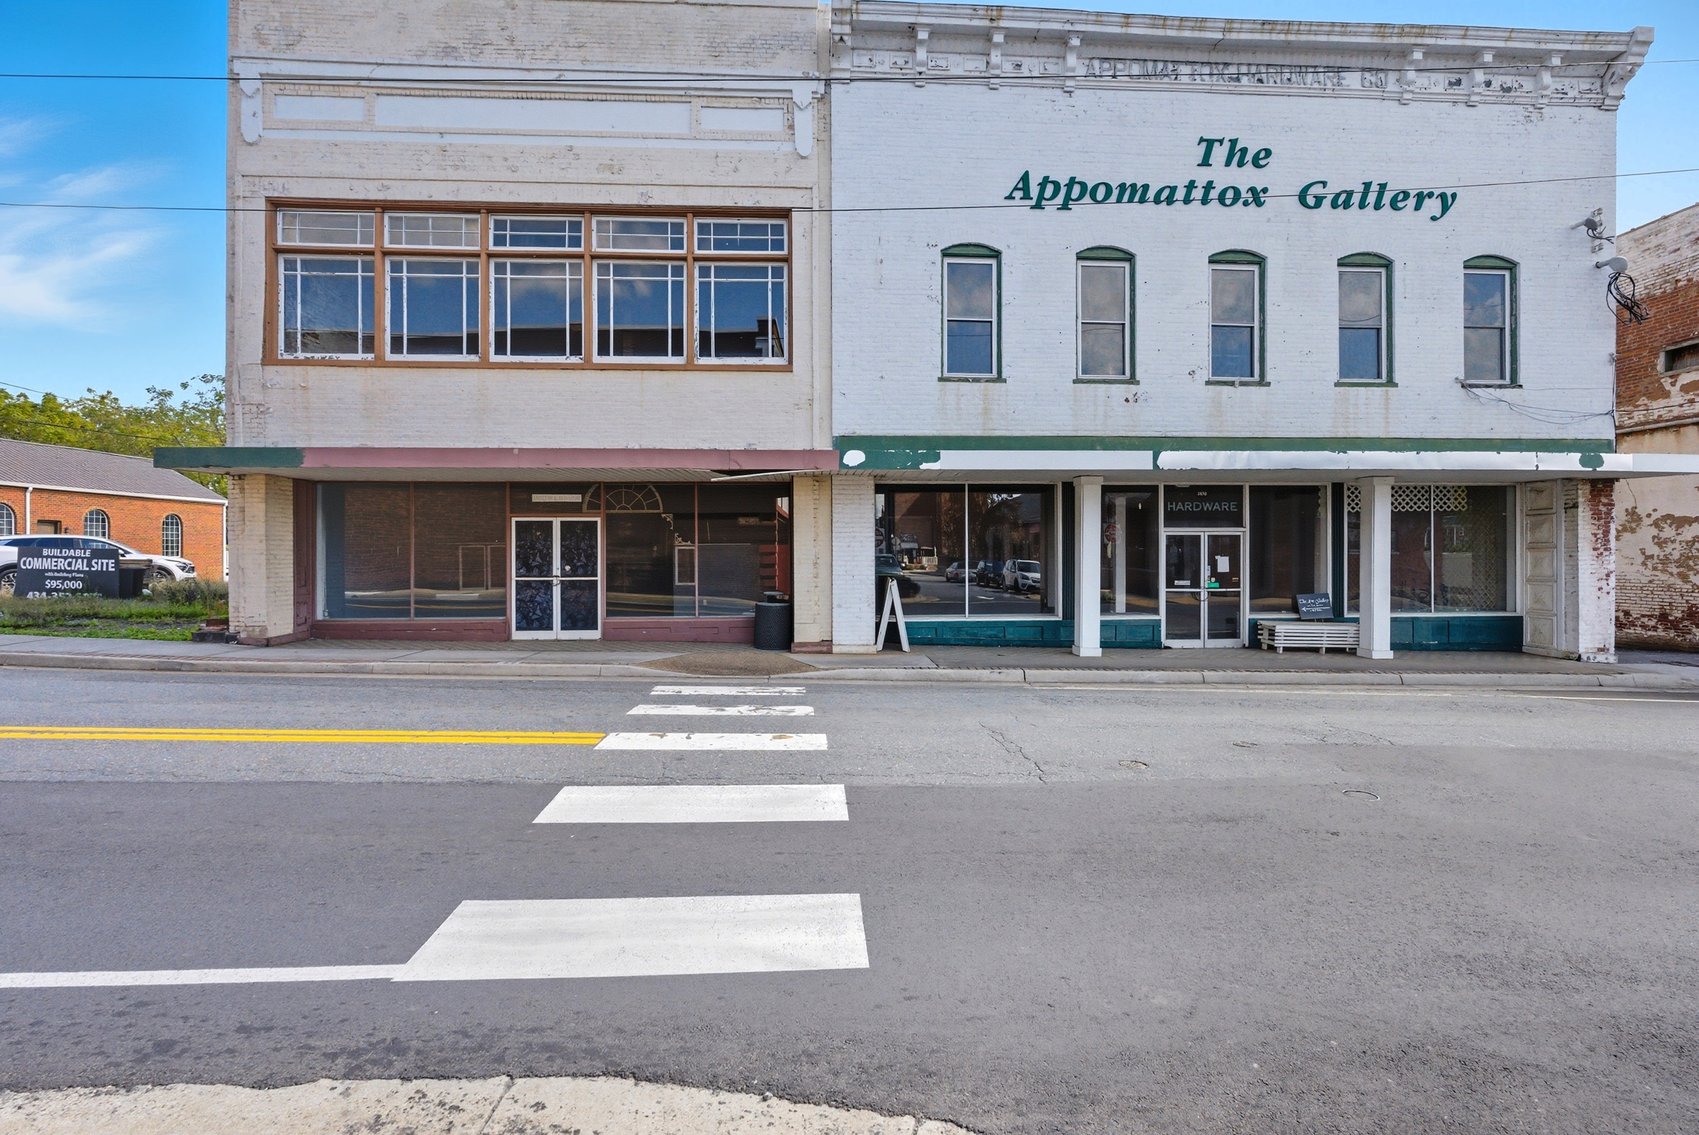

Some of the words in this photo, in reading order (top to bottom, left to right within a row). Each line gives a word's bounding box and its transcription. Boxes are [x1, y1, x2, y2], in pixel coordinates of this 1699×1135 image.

[1196, 135, 1273, 169] The
[1003, 169, 1270, 211] Appomattox
[1297, 180, 1458, 222] Gallery
[1167, 501, 1238, 512] HARDWARE
[42, 548, 91, 558] BUILDABLE
[20, 557, 89, 571] COMMERCIAL
[91, 559, 116, 572] SITE
[45, 579, 83, 590] $95,000
